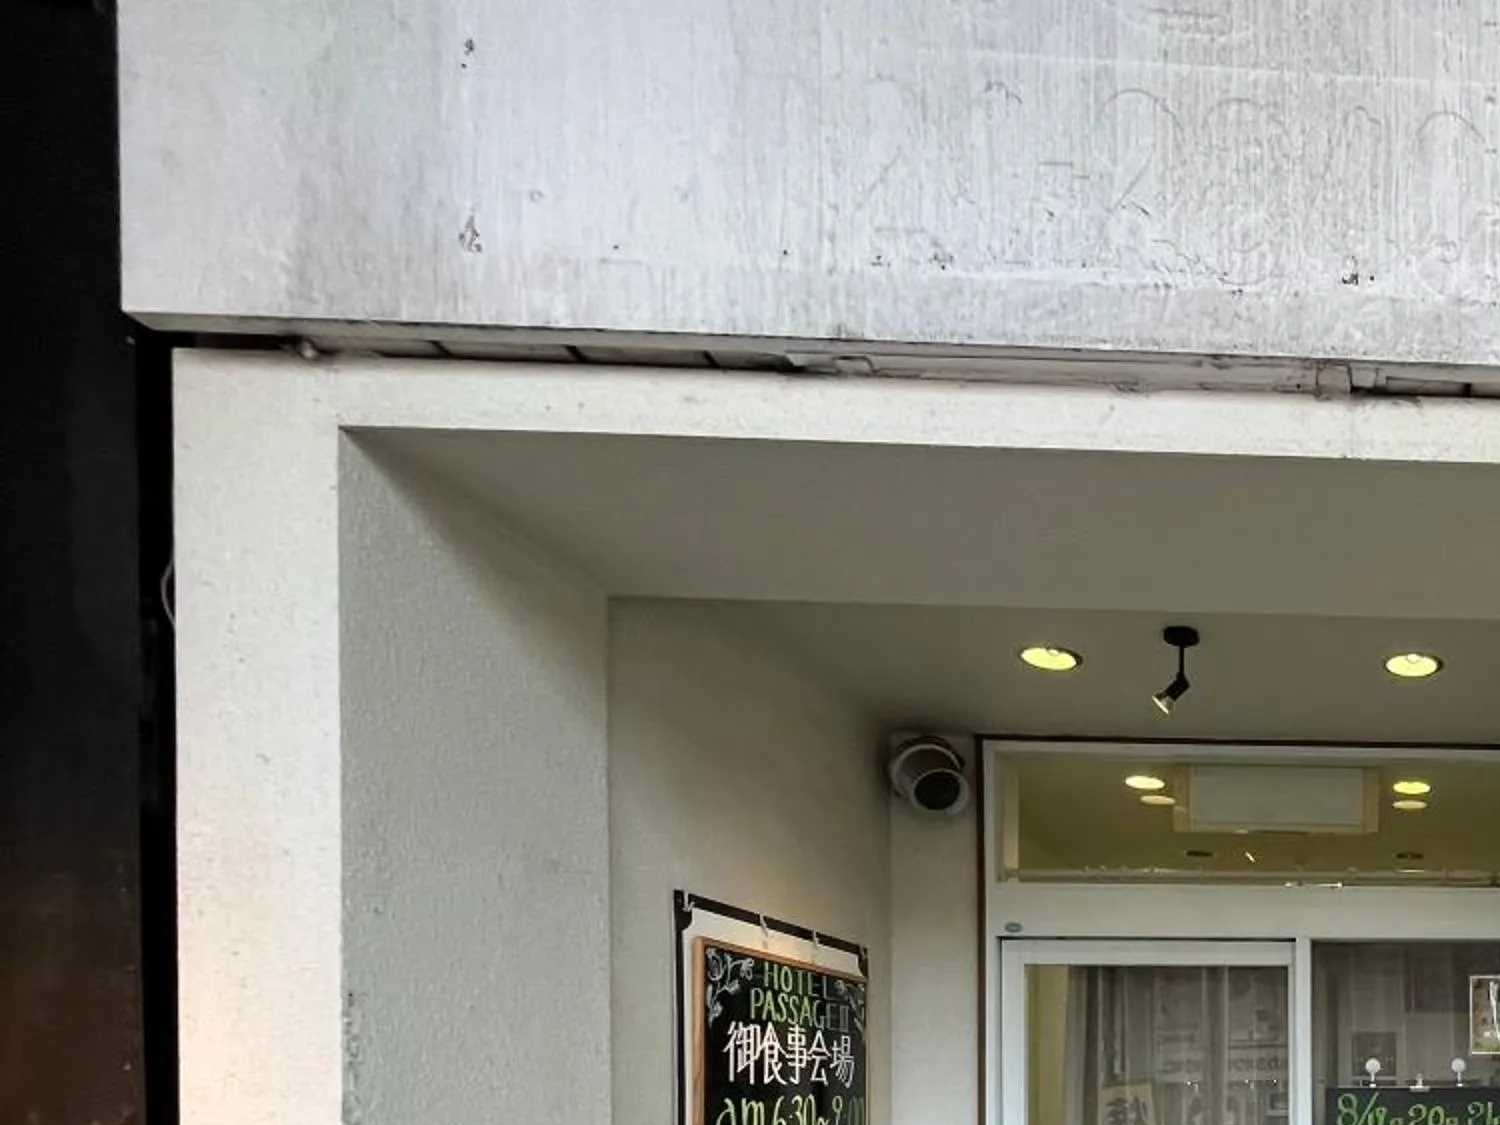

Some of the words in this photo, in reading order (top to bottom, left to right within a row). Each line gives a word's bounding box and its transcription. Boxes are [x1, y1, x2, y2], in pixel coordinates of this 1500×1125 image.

[763, 960, 833, 1000] HOTEL
[723, 1021, 856, 1088] 御食事会場
